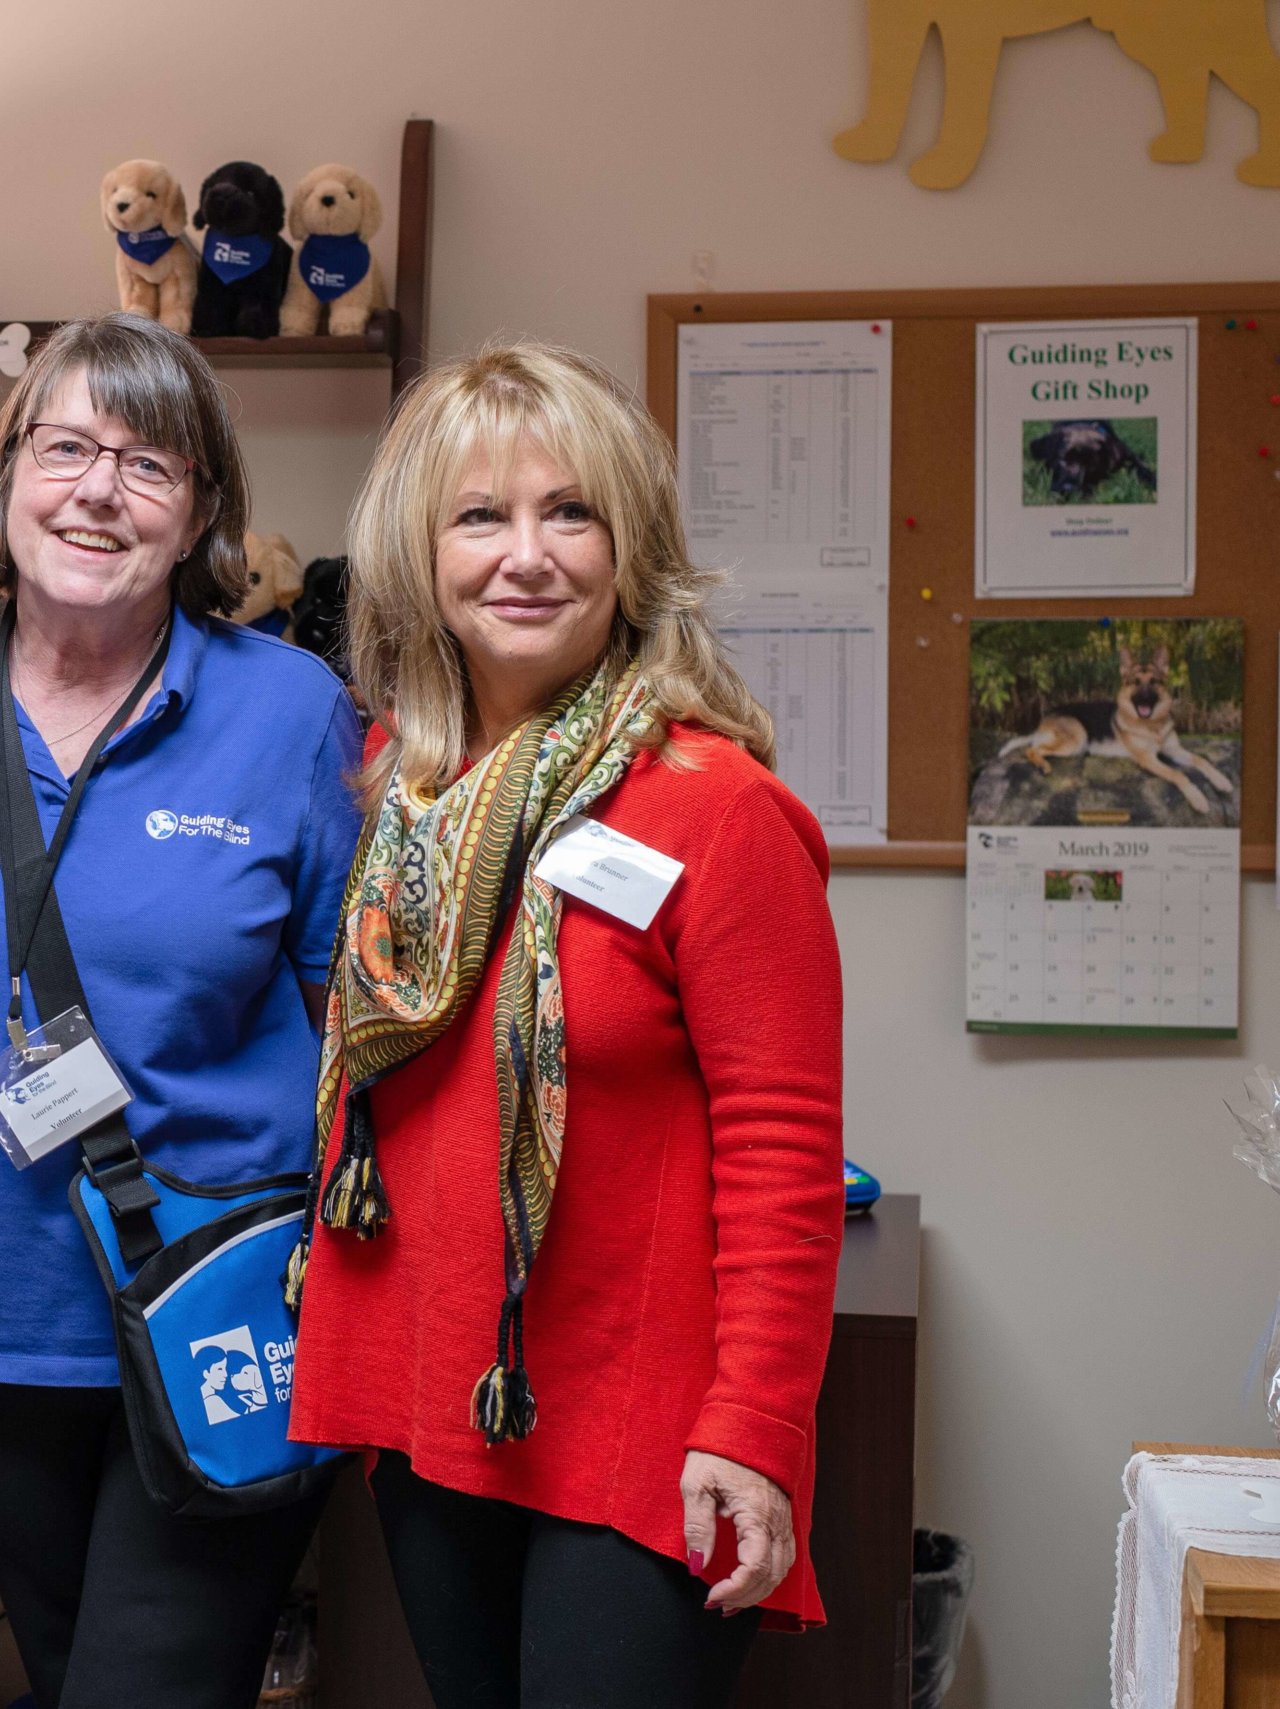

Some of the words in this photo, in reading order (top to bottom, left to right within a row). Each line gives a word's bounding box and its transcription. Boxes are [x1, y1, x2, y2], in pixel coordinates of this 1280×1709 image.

[1008, 343, 1108, 368] Guiding
[1117, 341, 1173, 368] Eyes
[1031, 380, 1078, 402] Gift
[1087, 379, 1149, 404] Shop
[181, 815, 226, 828] Guiding
[227, 819, 250, 834] Eyes
[179, 825, 200, 836] For
[200, 825, 223, 838] The
[224, 831, 250, 845] Blind
[1058, 841, 1110, 856] March
[1113, 841, 1149, 857] 2019
[599, 863, 628, 882] Brunner
[576, 876, 605, 892] lunteer
[26, 1071, 50, 1088] Guiding
[29, 1082, 44, 1093] Eyes
[31, 1104, 53, 1120] Laurie
[52, 1087, 78, 1107] Pappert
[50, 1108, 82, 1130] Volunteer
